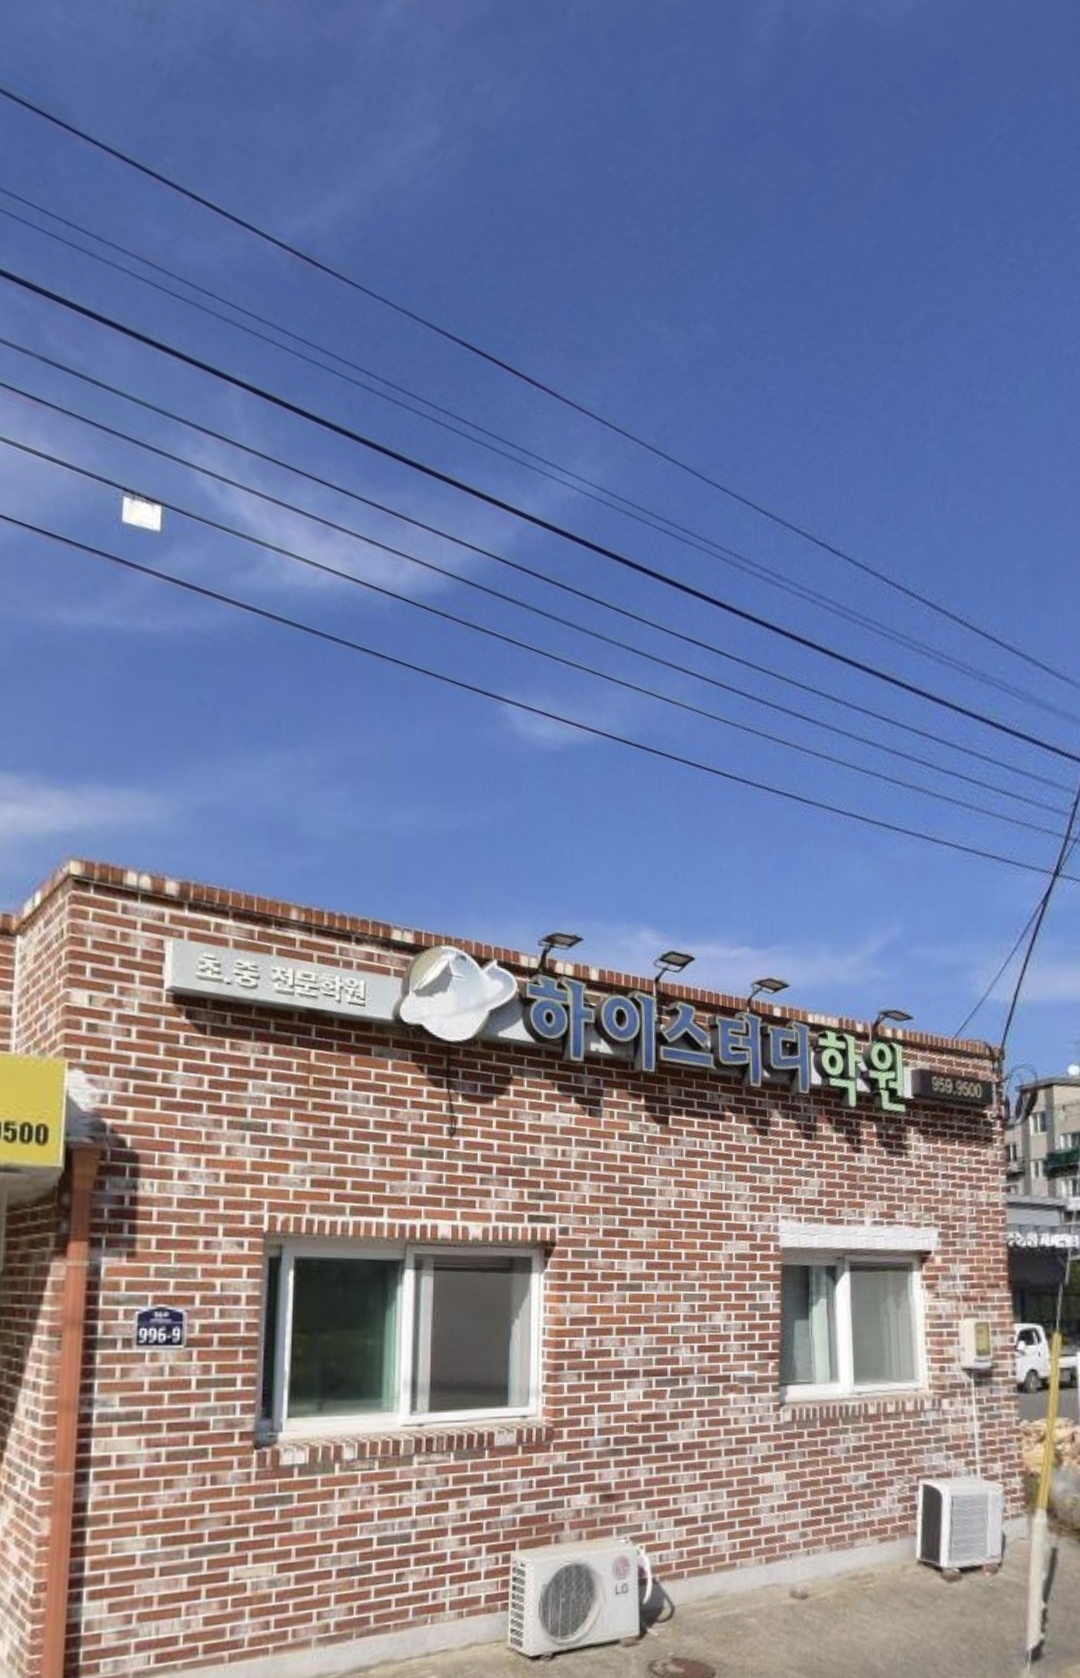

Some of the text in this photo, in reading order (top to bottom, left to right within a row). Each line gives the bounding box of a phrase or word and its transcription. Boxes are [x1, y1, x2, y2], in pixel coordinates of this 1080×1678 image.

[270, 966, 368, 1006] 전문학원
[0, 1120, 49, 1146] 500
[138, 1326, 181, 1344] 996-9
